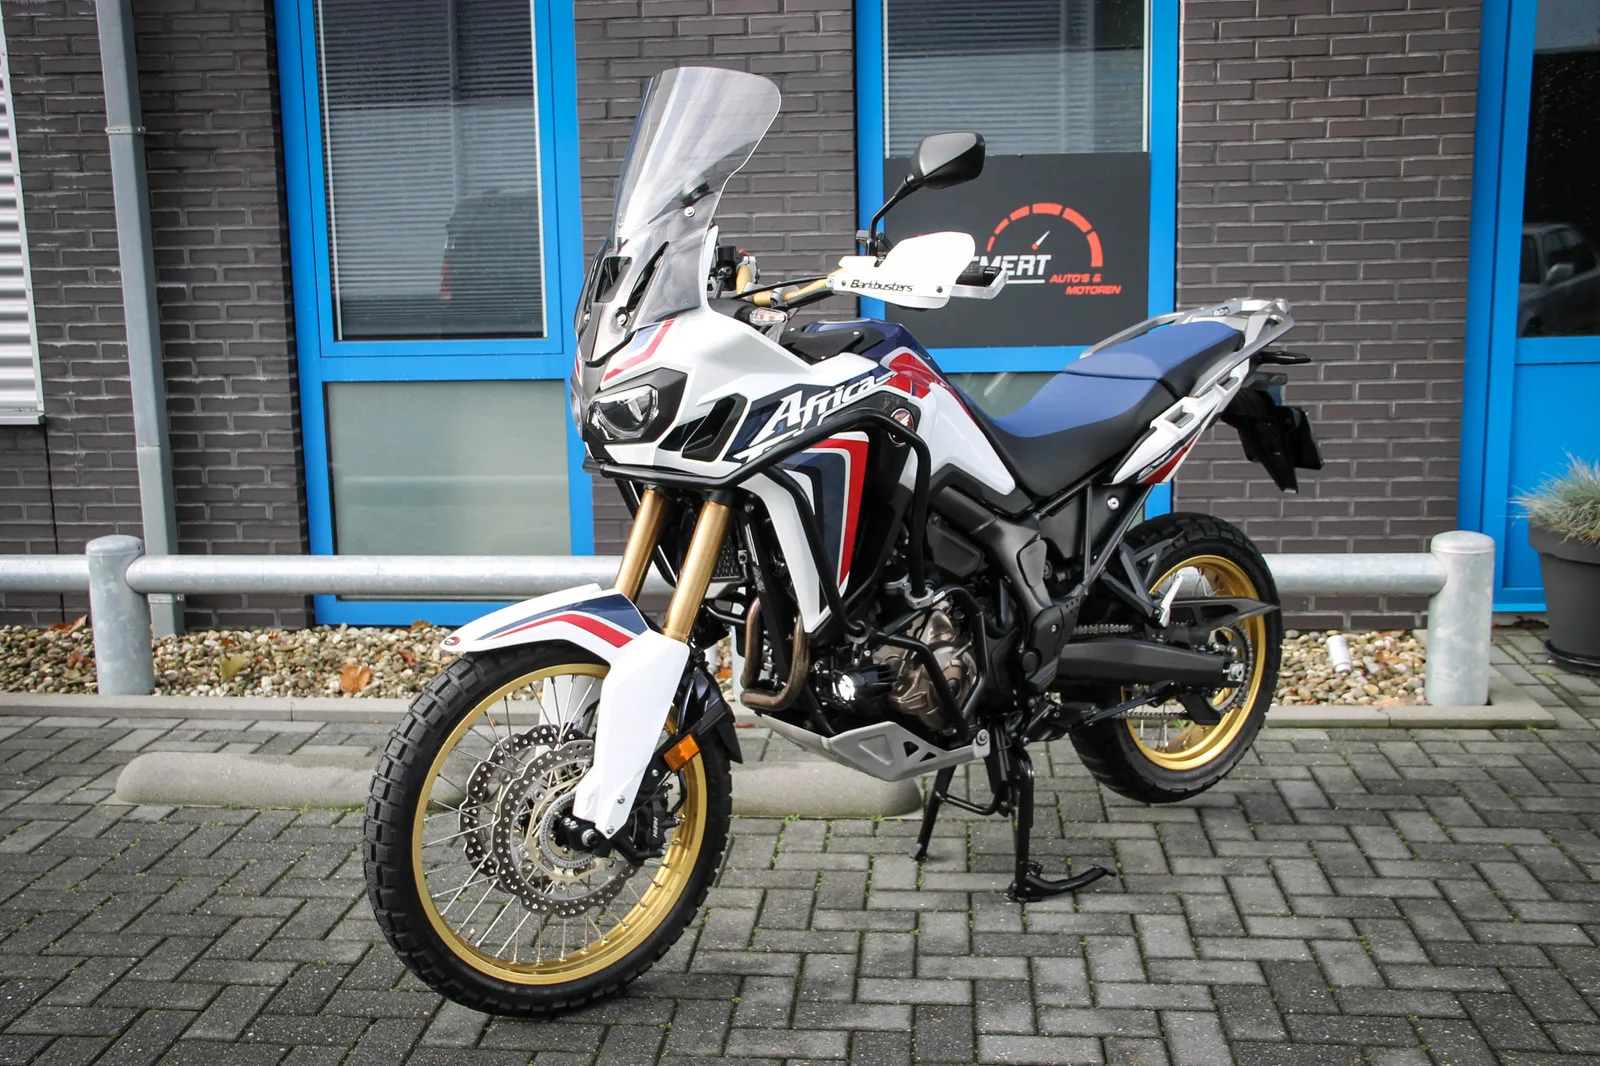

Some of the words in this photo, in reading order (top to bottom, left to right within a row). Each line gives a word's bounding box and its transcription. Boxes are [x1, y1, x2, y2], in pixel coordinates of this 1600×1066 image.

[971, 255, 1052, 276] MERT
[1050, 273, 1090, 283] AUTO'S
[1092, 273, 1102, 283] &
[850, 279, 913, 292] Barkbusters
[1065, 285, 1122, 295] MOTOREN
[748, 375, 892, 447] Africa
